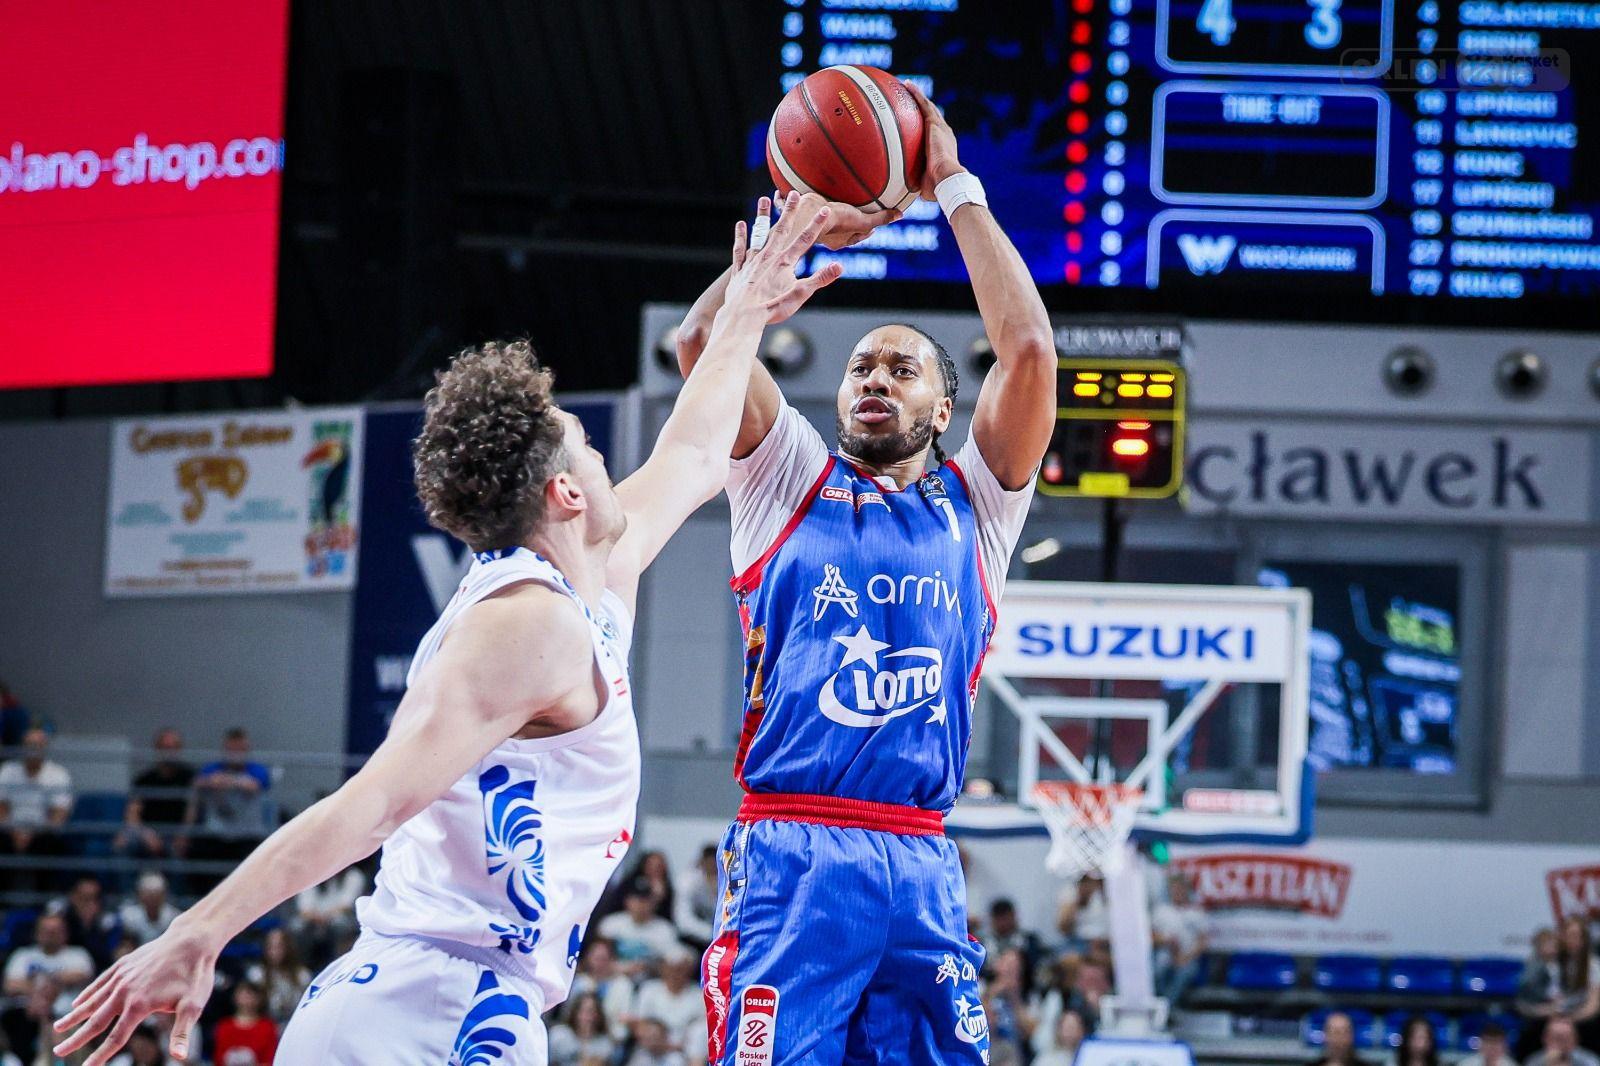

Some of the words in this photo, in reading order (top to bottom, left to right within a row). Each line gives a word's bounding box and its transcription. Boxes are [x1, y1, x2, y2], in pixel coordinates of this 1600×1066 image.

[1197, 0, 1236, 45] 4
[1305, 0, 1341, 48] 3
[1188, 430, 1545, 510] cławek
[1018, 623, 1255, 660] SUZUKI
[852, 664, 942, 712] LOTTO
[745, 997, 775, 1007] ORLEN
[739, 1051, 768, 1060] Basket
